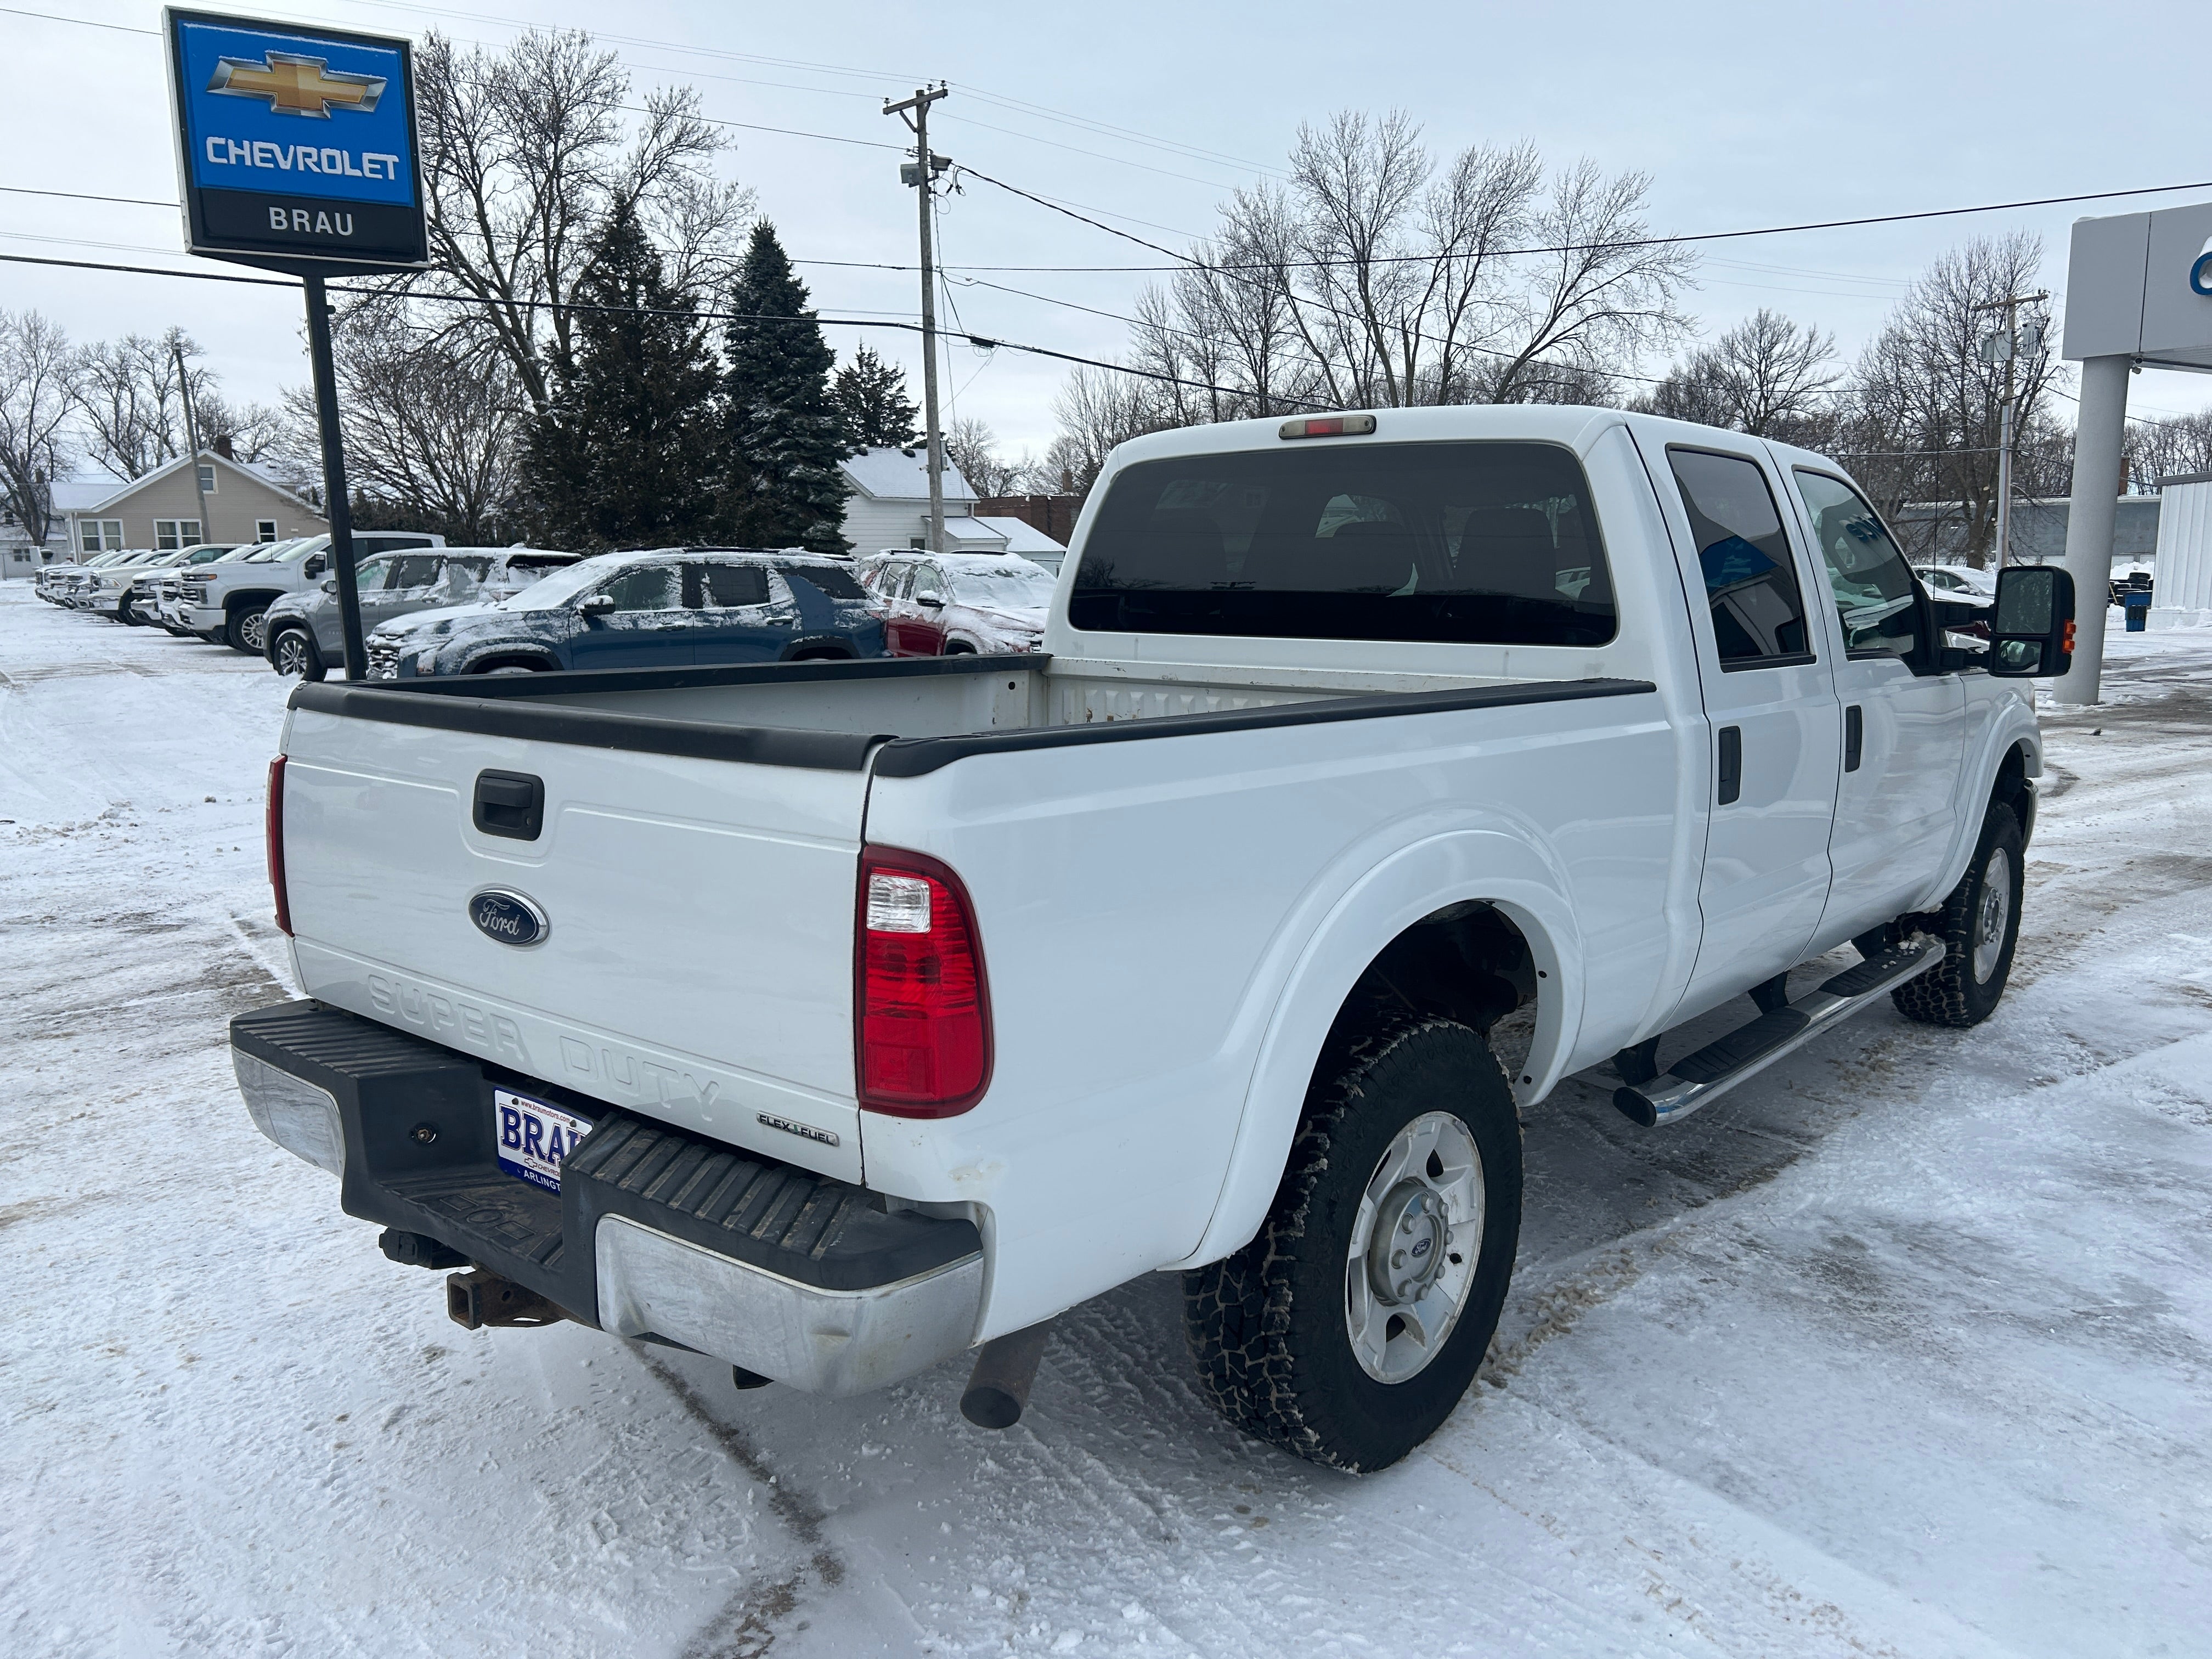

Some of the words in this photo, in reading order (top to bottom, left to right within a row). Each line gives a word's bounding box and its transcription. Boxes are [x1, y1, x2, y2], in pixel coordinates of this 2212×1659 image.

[206, 136, 399, 180] CHEVROLET
[269, 206, 353, 236] BRAU
[479, 899, 521, 935] Ford
[368, 973, 526, 1062] SUPER
[558, 1035, 720, 1121] DUTY
[520, 1099, 571, 1124] www.braumotors.com
[759, 1114, 791, 1132] FLEX
[800, 1127, 835, 1146] FUEL
